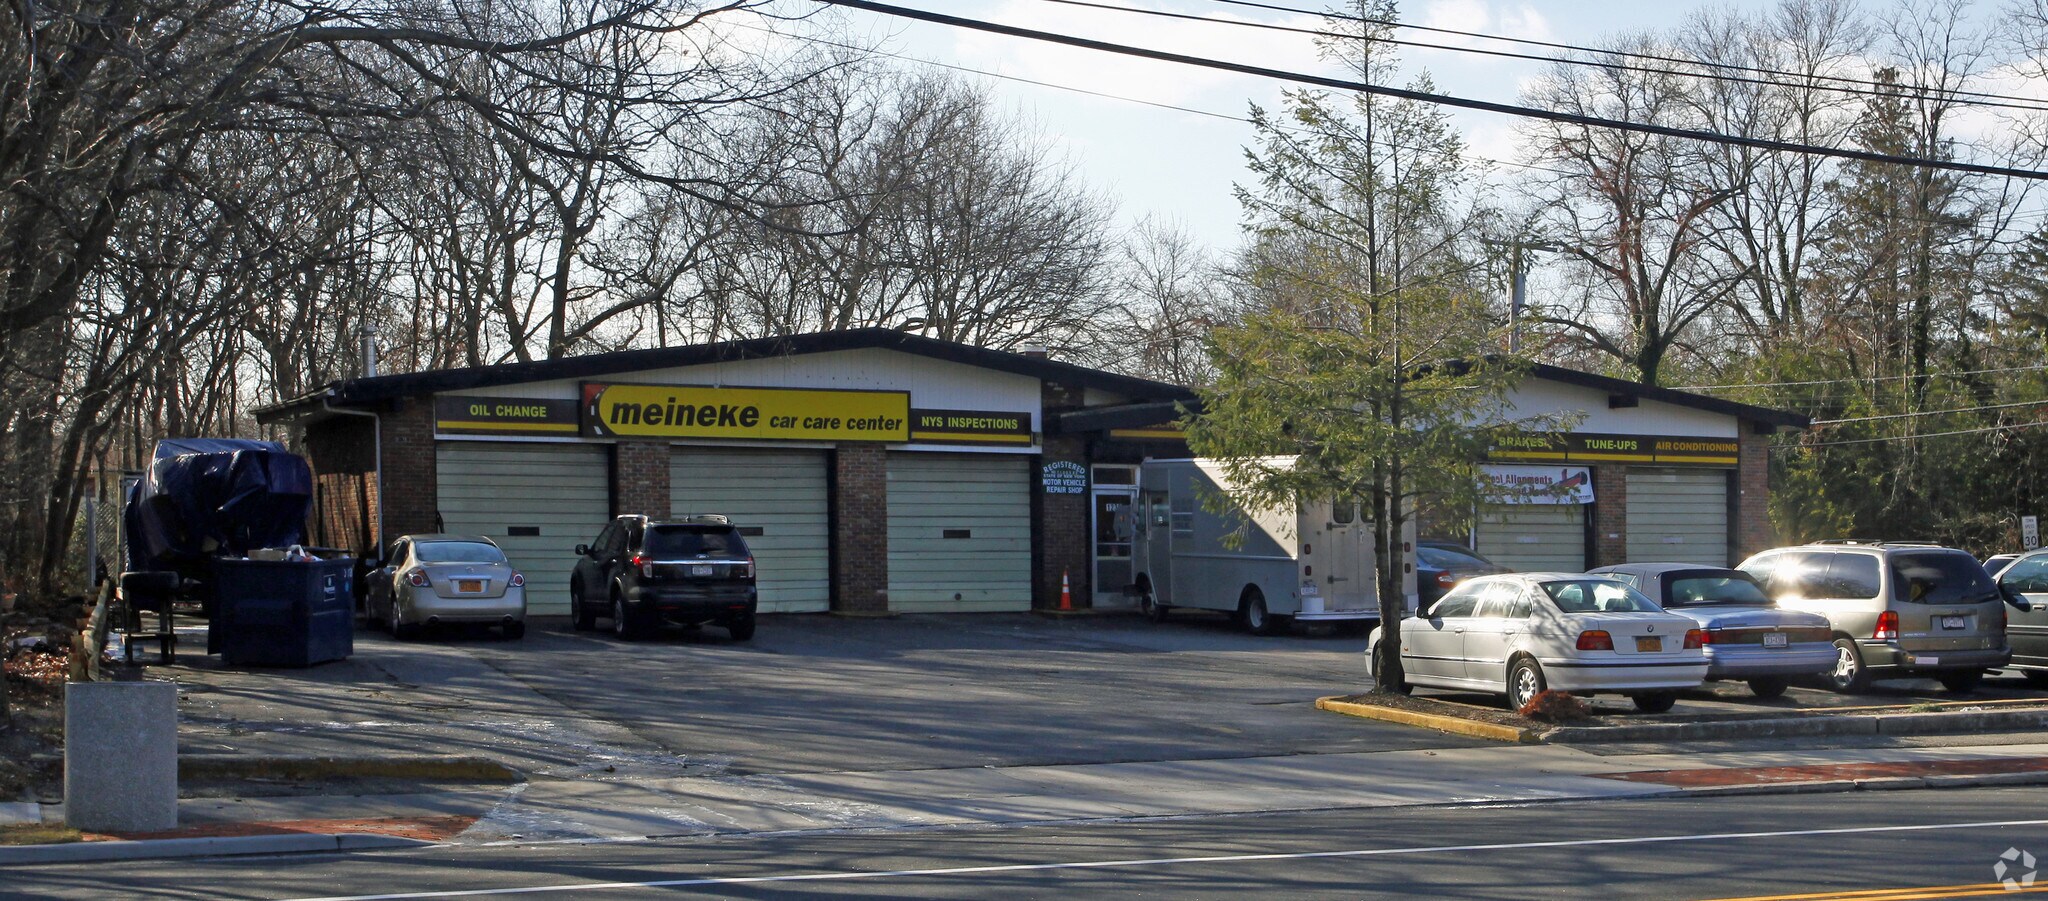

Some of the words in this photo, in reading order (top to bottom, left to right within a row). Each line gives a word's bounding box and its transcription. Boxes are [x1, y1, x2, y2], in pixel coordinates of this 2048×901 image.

[470, 404, 490, 416] OIL
[496, 405, 547, 418] CHANGE
[610, 397, 760, 427] meineke
[769, 415, 798, 429] car
[802, 415, 841, 431] care
[846, 415, 903, 432] center
[921, 416, 943, 428] NYS
[948, 416, 1019, 430] INSPECTIONS
[1498, 437, 1545, 448] BRAKES
[1585, 439, 1638, 451] TUNE-UPS
[1655, 441, 1672, 451] AIR
[1672, 442, 1738, 452] CONDITIONING
[1043, 461, 1085, 474] REGISTERED
[1063, 479, 1086, 487] VEHICLE
[2025, 536, 2037, 546] 30
